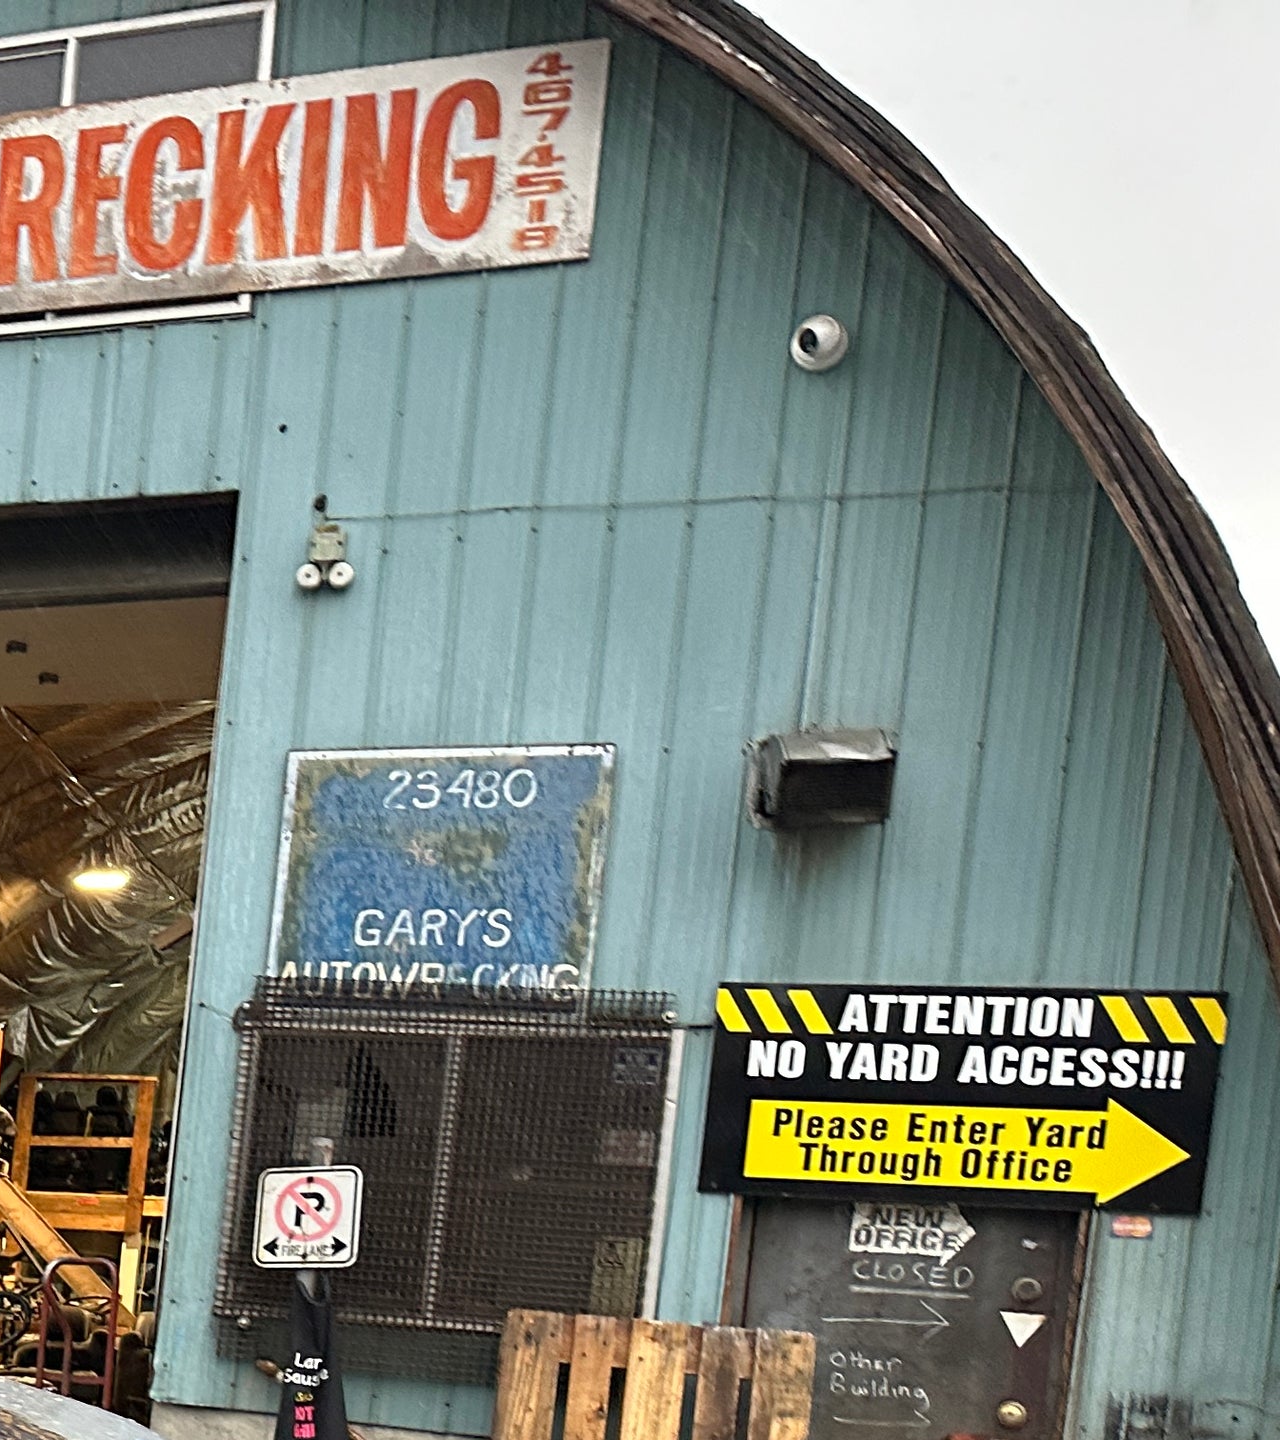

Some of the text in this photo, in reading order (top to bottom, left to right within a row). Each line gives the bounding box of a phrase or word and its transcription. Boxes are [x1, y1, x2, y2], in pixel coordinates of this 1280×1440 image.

[383, 768, 539, 809] 23480
[353, 907, 513, 948] GARY'S
[837, 993, 1094, 1039] ATTENTION
[746, 1039, 1185, 1090] NO YARD ACCESS!!!
[772, 1108, 1107, 1151] Please Enter Yard
[798, 1142, 1074, 1184] Through Office
[854, 1225, 963, 1250] OFFICE
[852, 1259, 975, 1289] CLOSED
[829, 1350, 903, 1372] Other
[830, 1371, 931, 1413] Building
